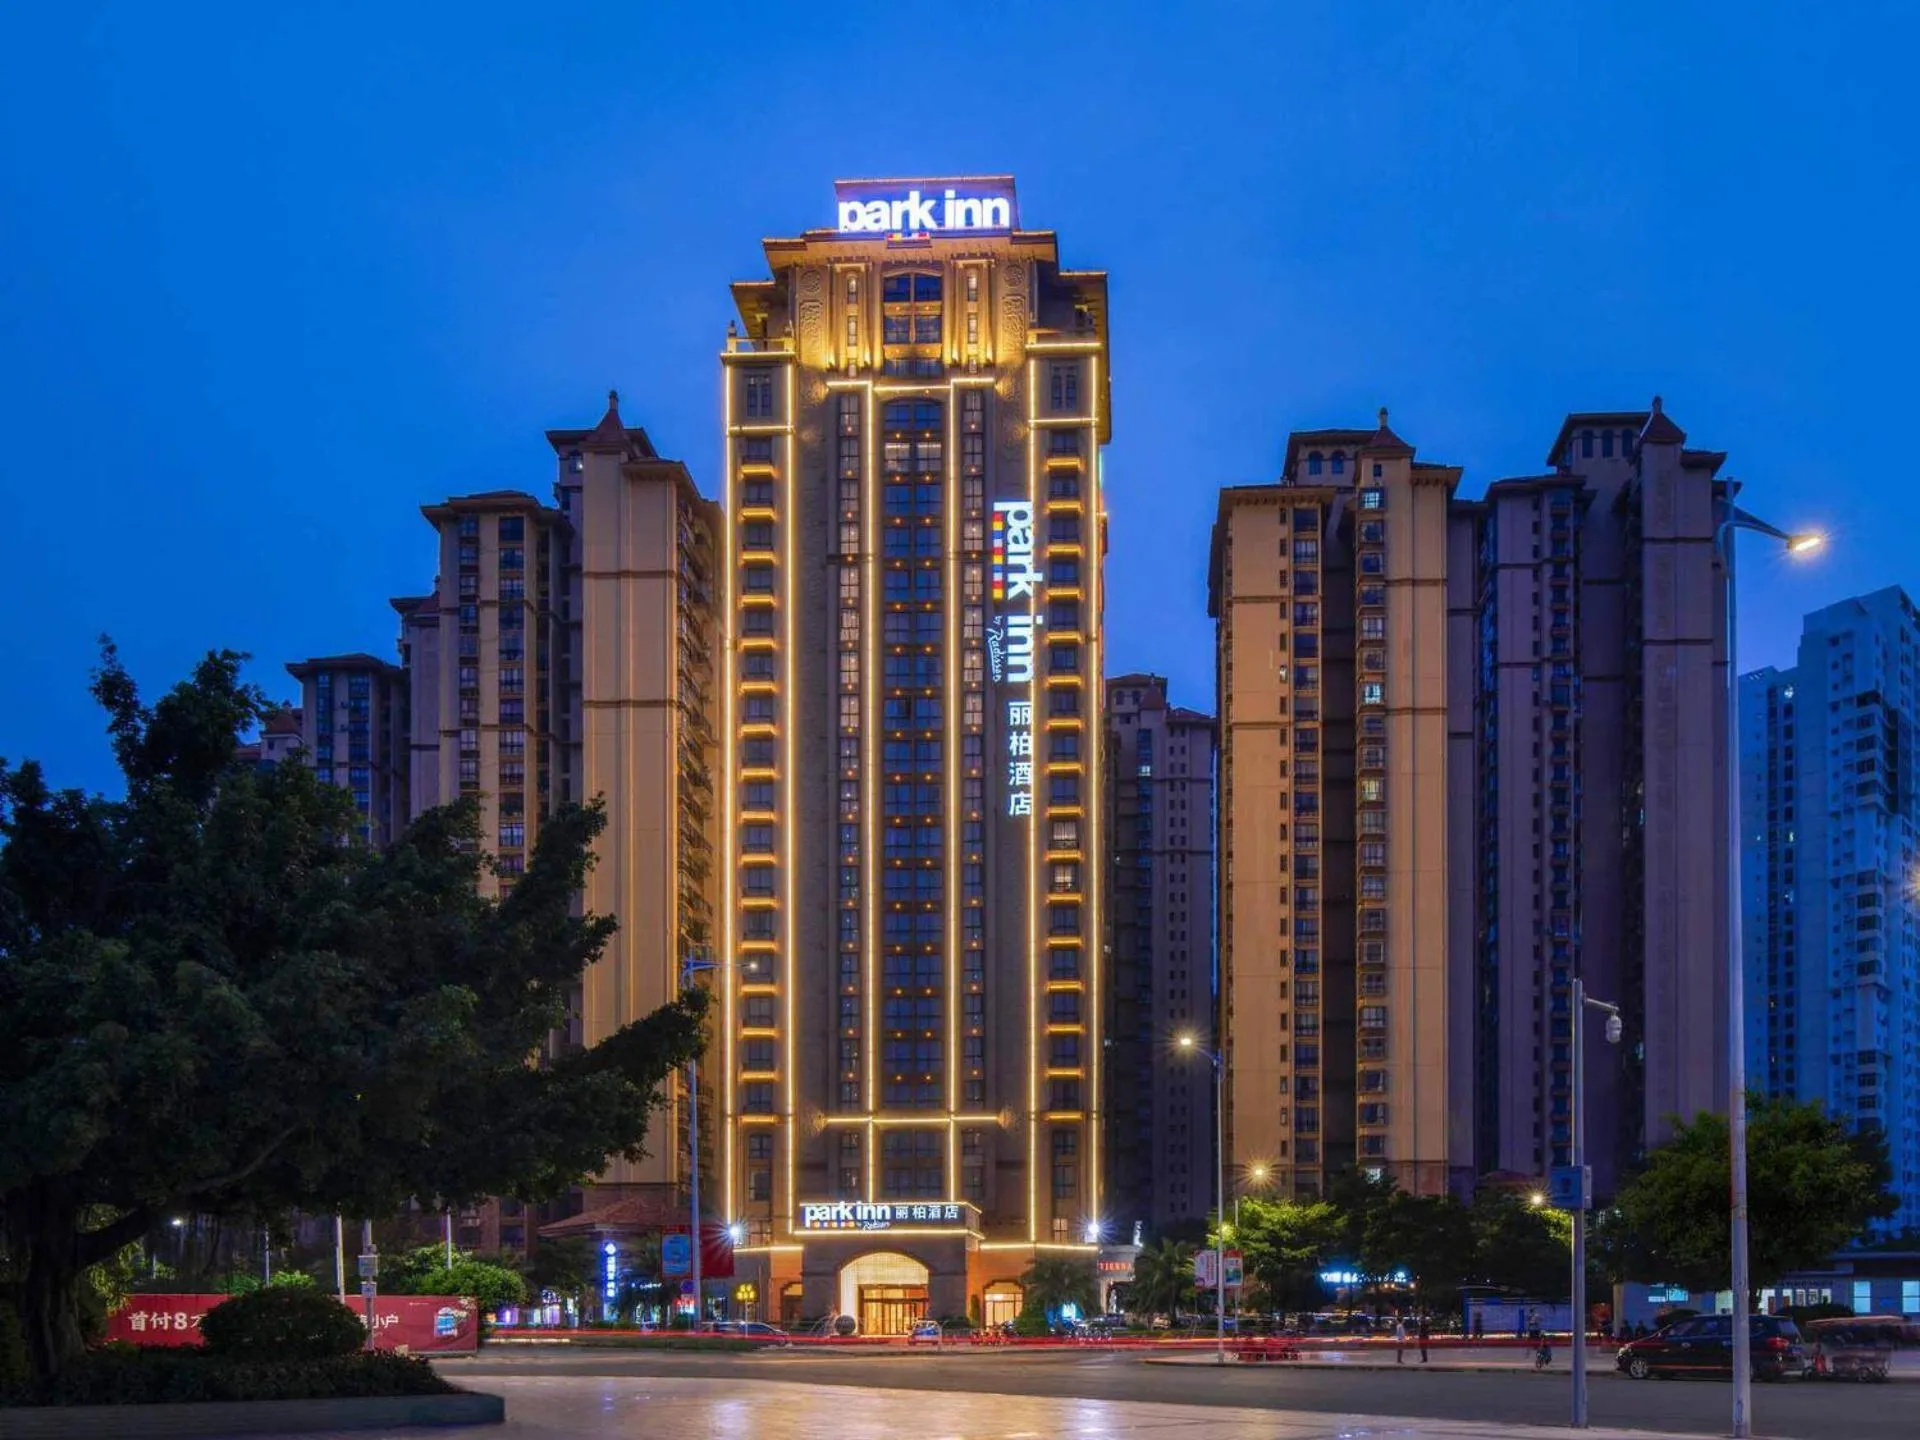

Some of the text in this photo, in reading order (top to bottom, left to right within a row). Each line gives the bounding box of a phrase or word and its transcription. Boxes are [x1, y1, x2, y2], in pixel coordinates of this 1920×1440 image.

[838, 189, 1010, 233] park inn
[993, 501, 1044, 682] park inn
[1008, 701, 1034, 816] 丽柏酒店
[805, 1201, 854, 1228] park
[856, 1201, 891, 1219] inn
[895, 1205, 959, 1219] 丽柏酒店
